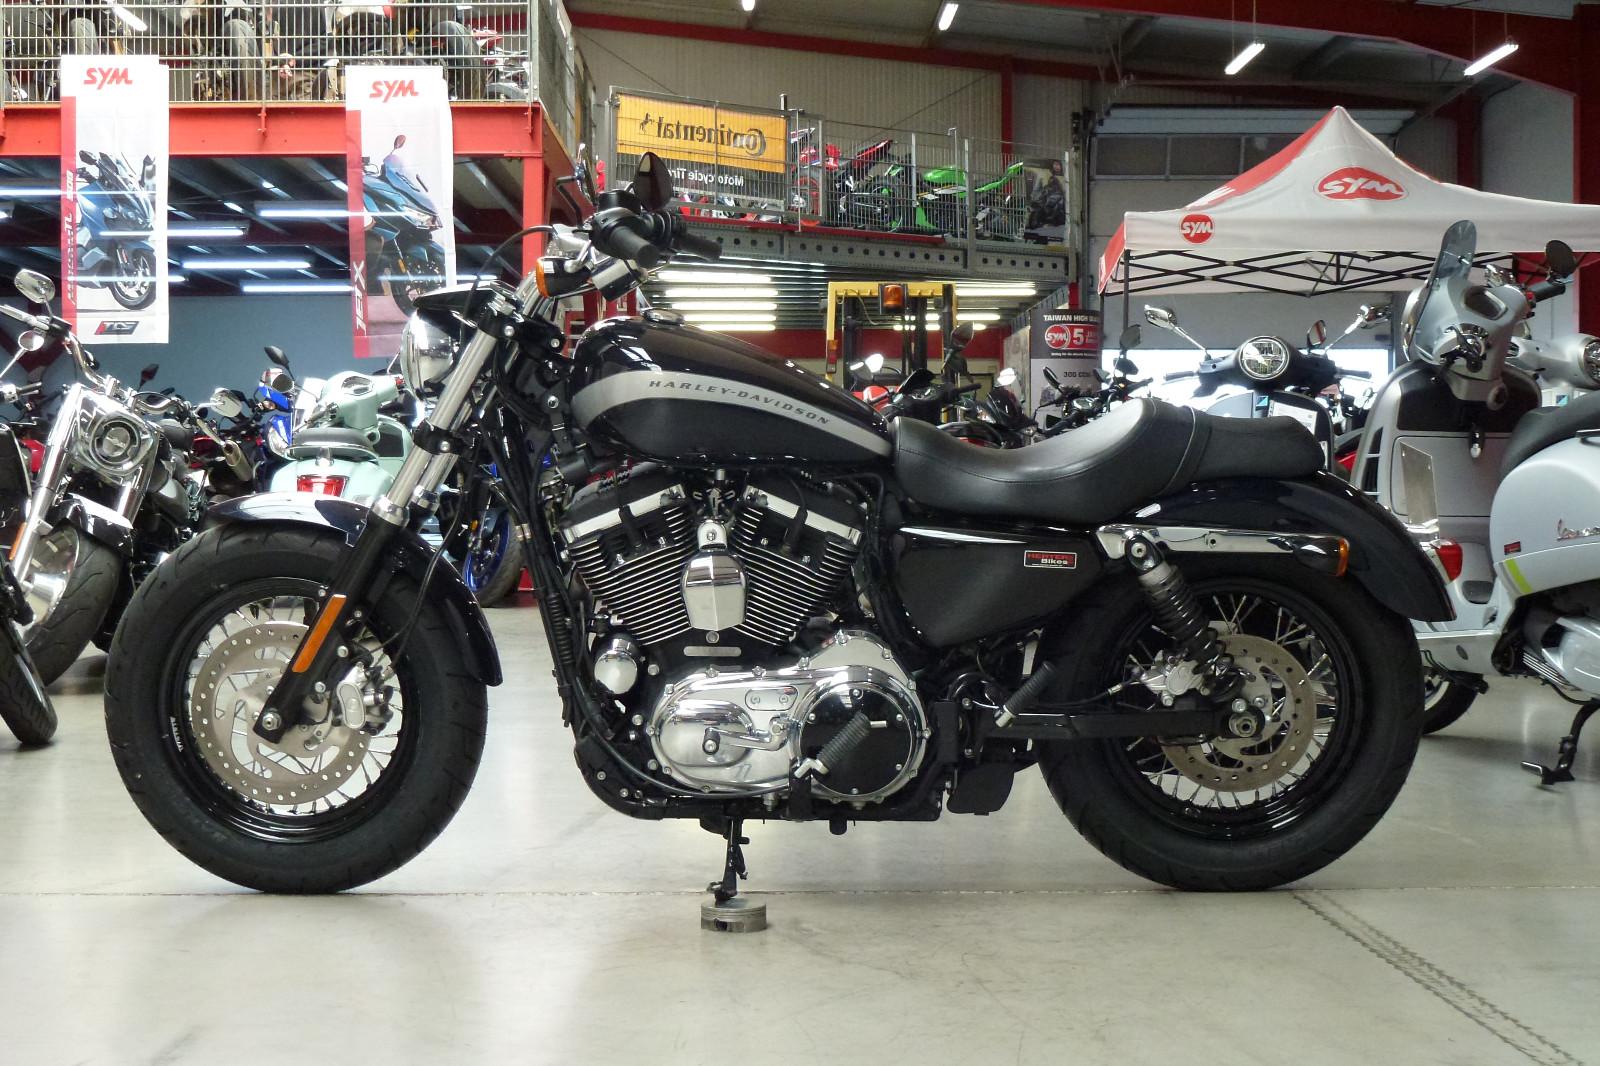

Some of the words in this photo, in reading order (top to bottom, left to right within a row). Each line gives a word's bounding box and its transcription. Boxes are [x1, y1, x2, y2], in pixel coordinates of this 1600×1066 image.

[83, 67, 133, 90] SYM
[369, 79, 420, 103] SYM
[1319, 178, 1406, 196] SYM
[1181, 221, 1213, 237] SYM
[1043, 314, 1072, 322] TAIWAN
[1072, 328, 1084, 346] 5
[649, 380, 830, 425] HARLEY-DAVIDSON
